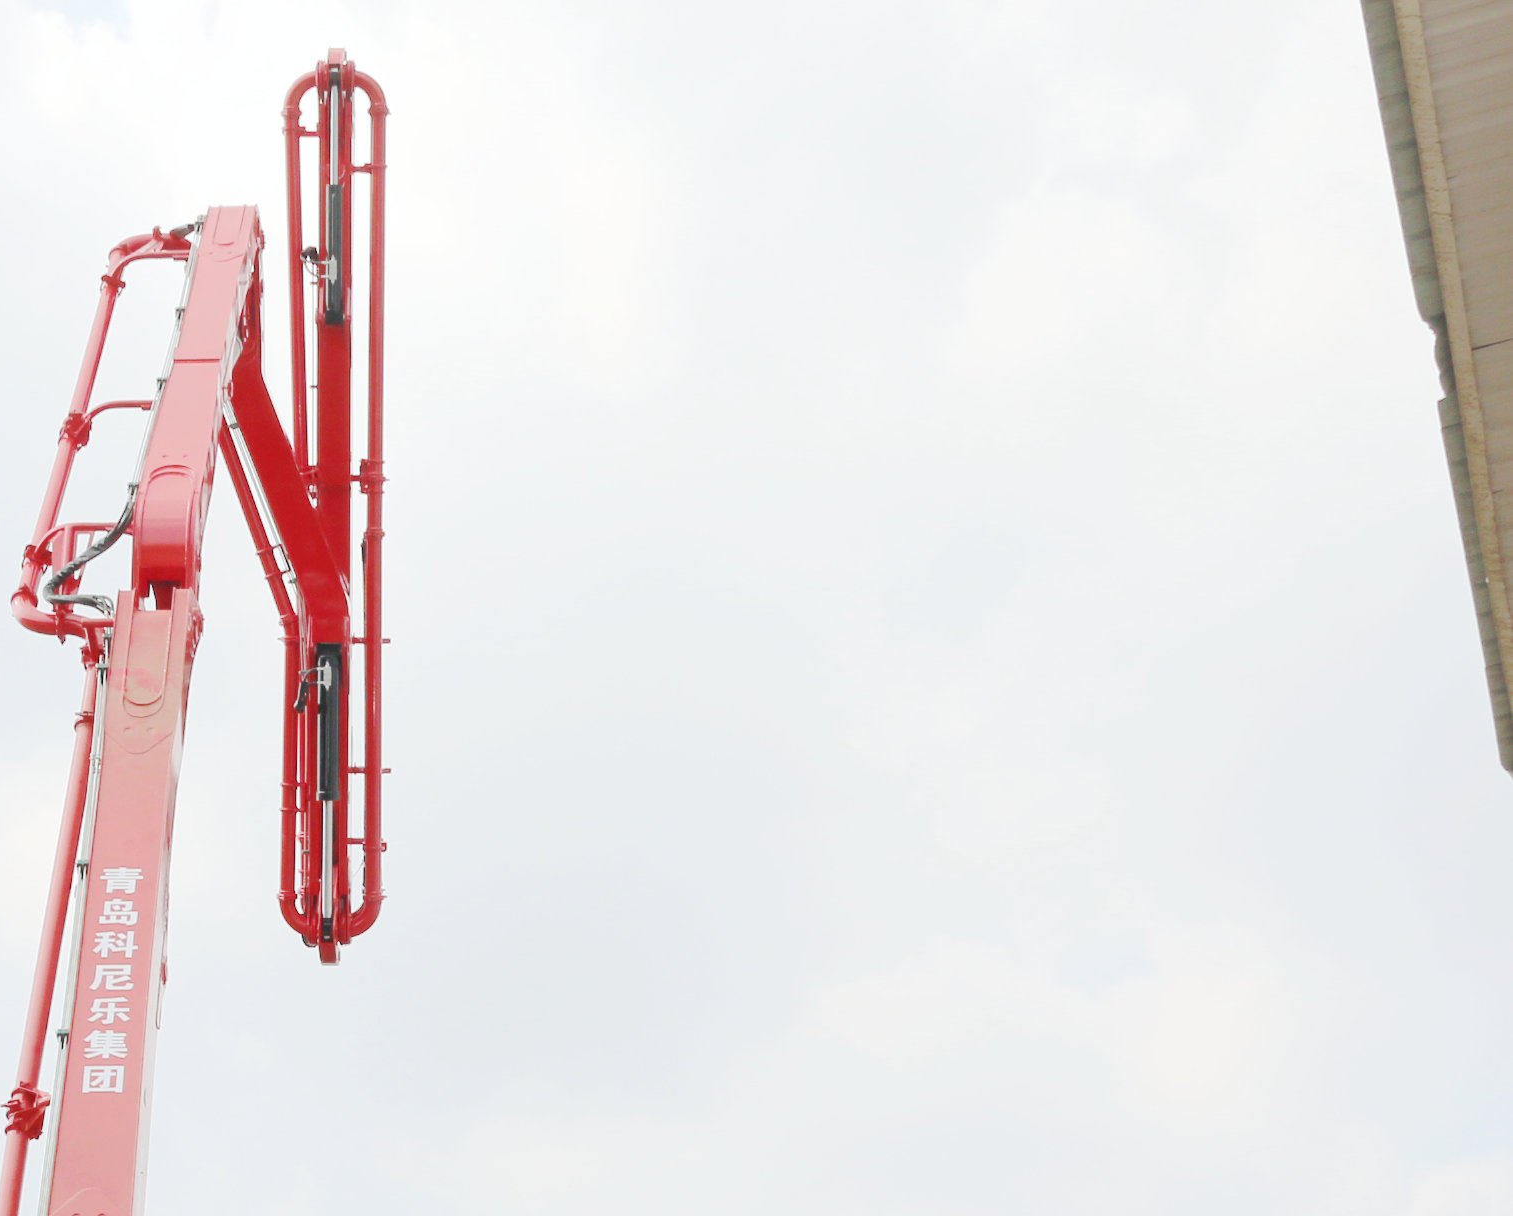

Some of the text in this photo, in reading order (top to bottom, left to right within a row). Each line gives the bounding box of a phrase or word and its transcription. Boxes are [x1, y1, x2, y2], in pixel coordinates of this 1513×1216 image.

[81, 866, 144, 1094] 青岛科尼乐集团
